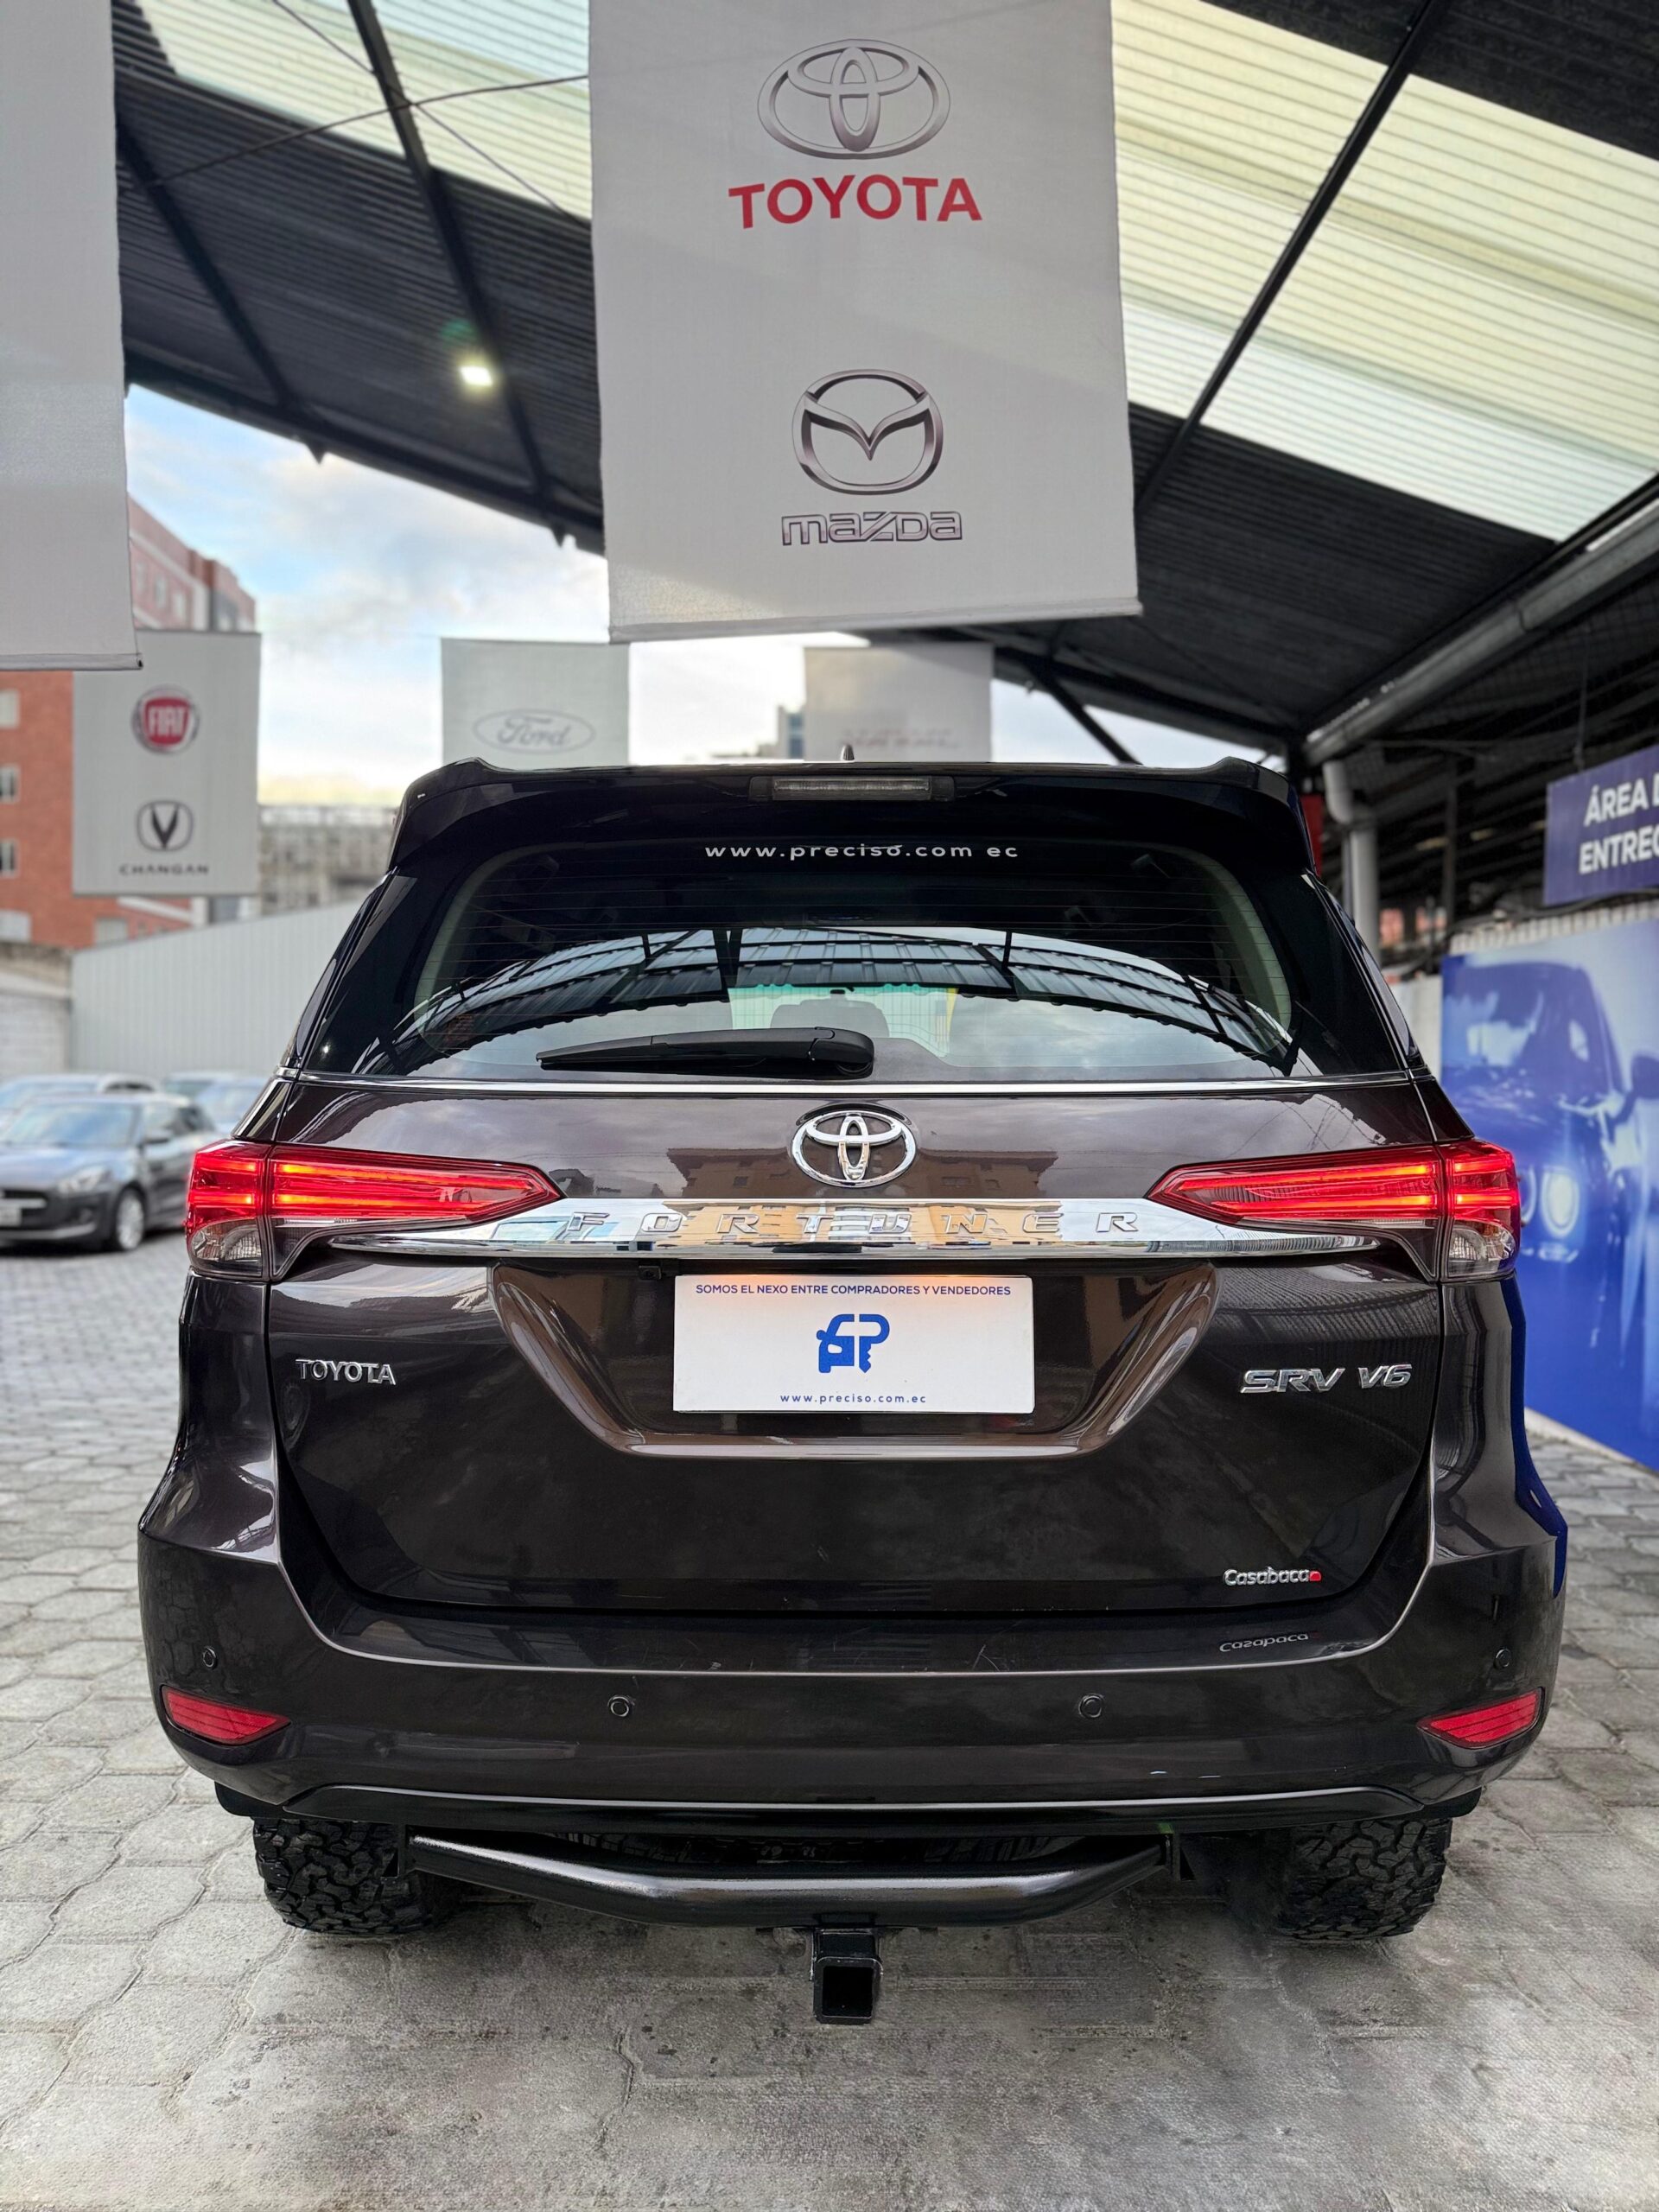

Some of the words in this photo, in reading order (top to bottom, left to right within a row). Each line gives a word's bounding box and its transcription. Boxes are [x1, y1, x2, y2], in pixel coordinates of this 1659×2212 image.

[728, 175, 982, 229] TOYOTA
[148, 706, 186, 736] FIAT
[497, 715, 572, 746] Ford
[1583, 778, 1649, 827] ÁREA
[118, 864, 209, 876] CHANGAN
[565, 1211, 1141, 1235] FORTUNER
[696, 1284, 738, 1294] SOMOS
[741, 1285, 754, 1294] EL
[757, 1285, 788, 1294] NEXO
[791, 1285, 829, 1294] ENTRE
[830, 1285, 920, 1295] COMPRADORES
[922, 1286, 931, 1294] Y
[931, 1286, 1011, 1295] VENDEDORES
[295, 1359, 397, 1385] TOYOTA
[1240, 1368, 1346, 1394] SRV
[1357, 1363, 1413, 1389] V6
[779, 1394, 926, 1405] www.preciso.com.ec
[1224, 1566, 1310, 1586] Casabaca
